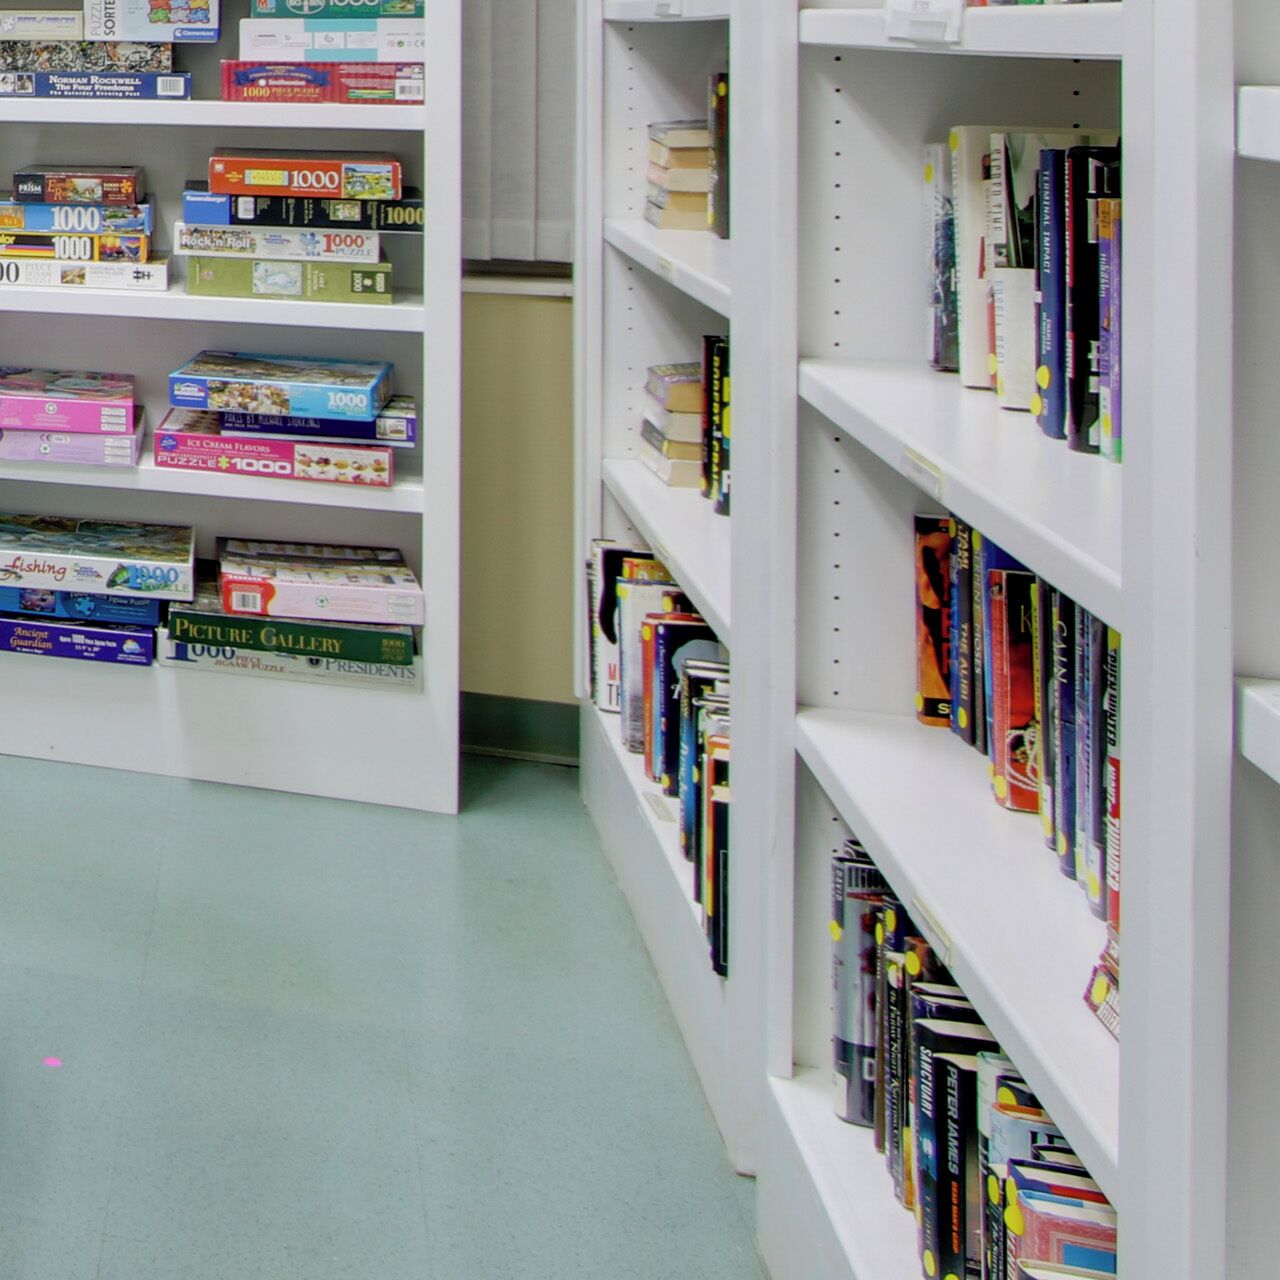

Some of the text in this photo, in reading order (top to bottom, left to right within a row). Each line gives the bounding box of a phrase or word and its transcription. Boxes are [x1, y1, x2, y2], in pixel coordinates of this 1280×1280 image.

[291, 171, 339, 188] 1000
[51, 207, 100, 230] 1000
[386, 207, 424, 225] 1000
[52, 236, 90, 259] 1000
[323, 234, 364, 253] 1000
[327, 391, 367, 408] 1000
[158, 454, 292, 474] PUZZLE 1000
[5, 556, 68, 582] fishing
[14, 627, 49, 639] Ancient
[175, 618, 344, 653] PICTURE GALLERY
[10, 637, 53, 650] Guardian
[919, 1046, 934, 1119] SANCTUARY
[947, 1066, 958, 1175] PETER JAMES
